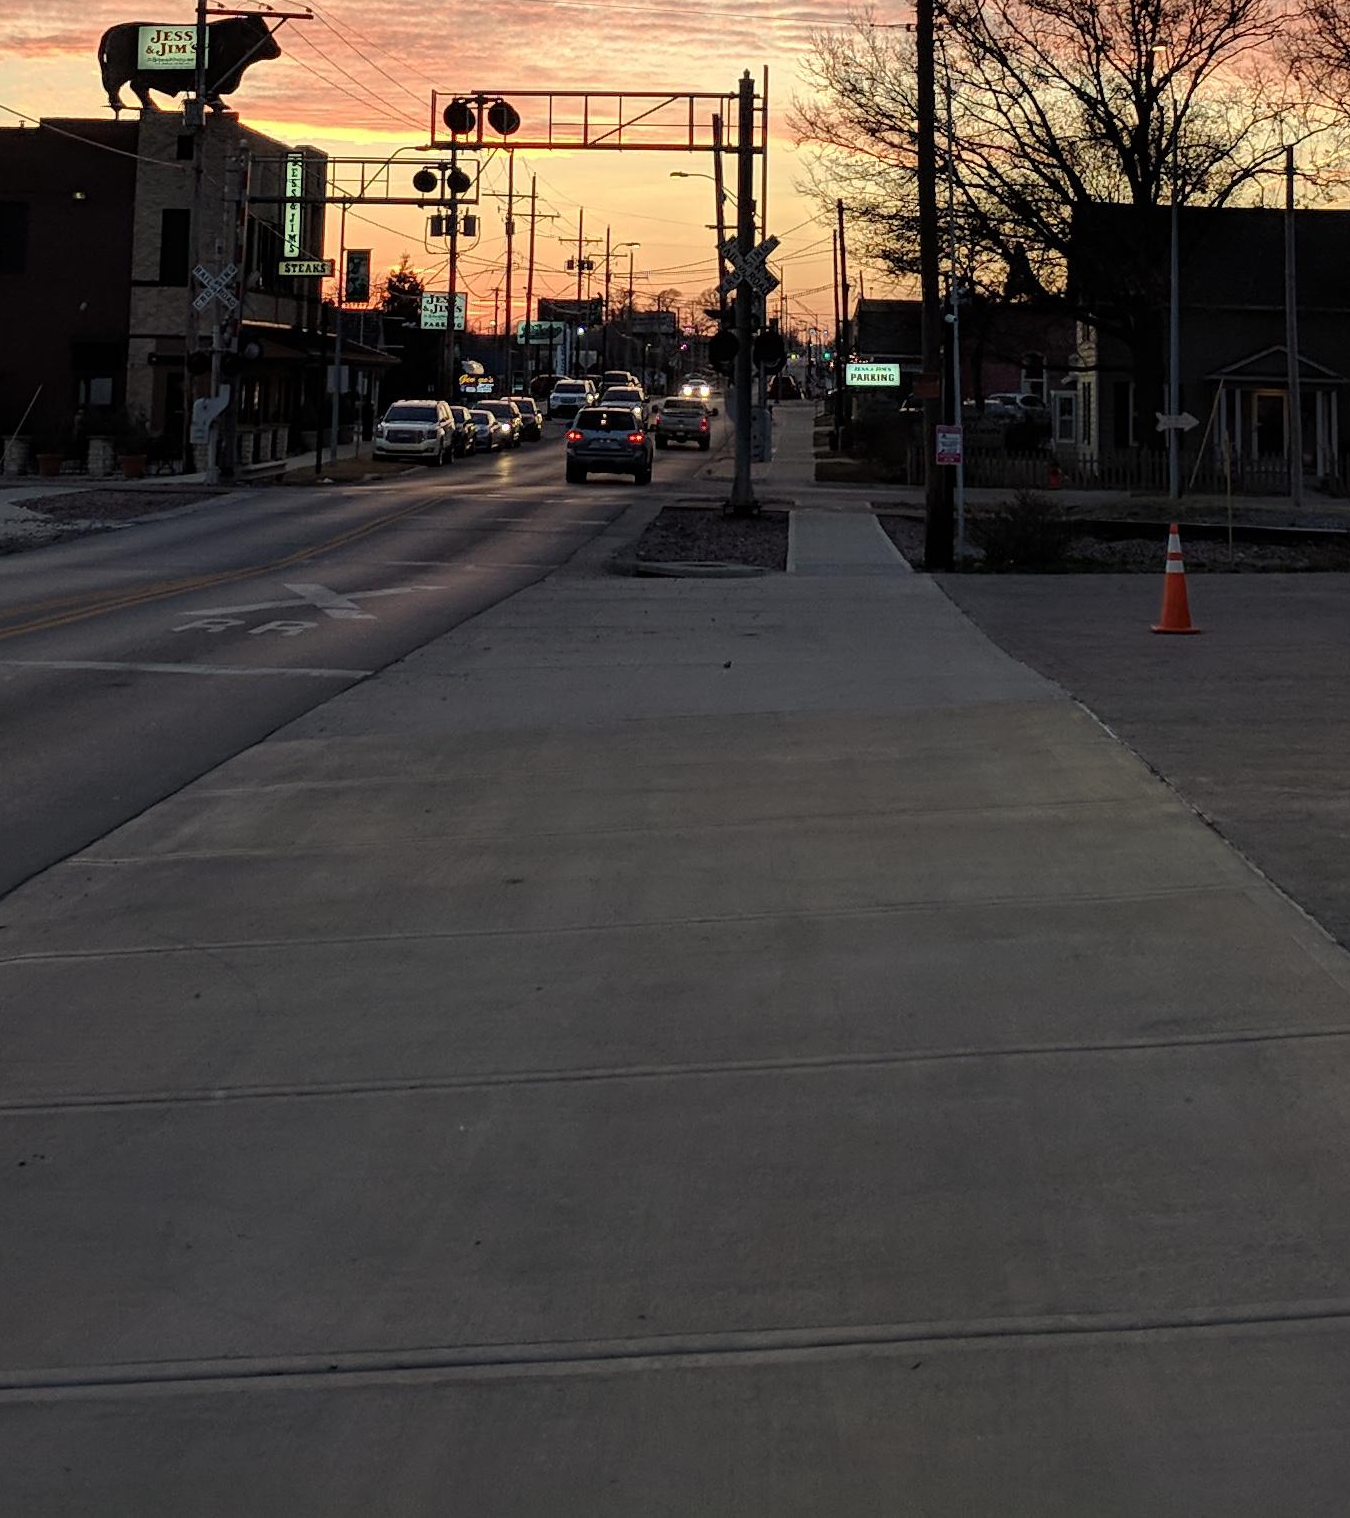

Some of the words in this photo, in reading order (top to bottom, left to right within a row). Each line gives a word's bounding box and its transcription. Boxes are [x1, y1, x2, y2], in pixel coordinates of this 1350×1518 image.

[151, 30, 193, 43] JESS
[146, 45, 154, 54] &
[284, 263, 326, 273] STEAKS
[195, 267, 212, 285] RAIL
[218, 288, 236, 307] ROAD
[851, 373, 895, 381] PARKING
